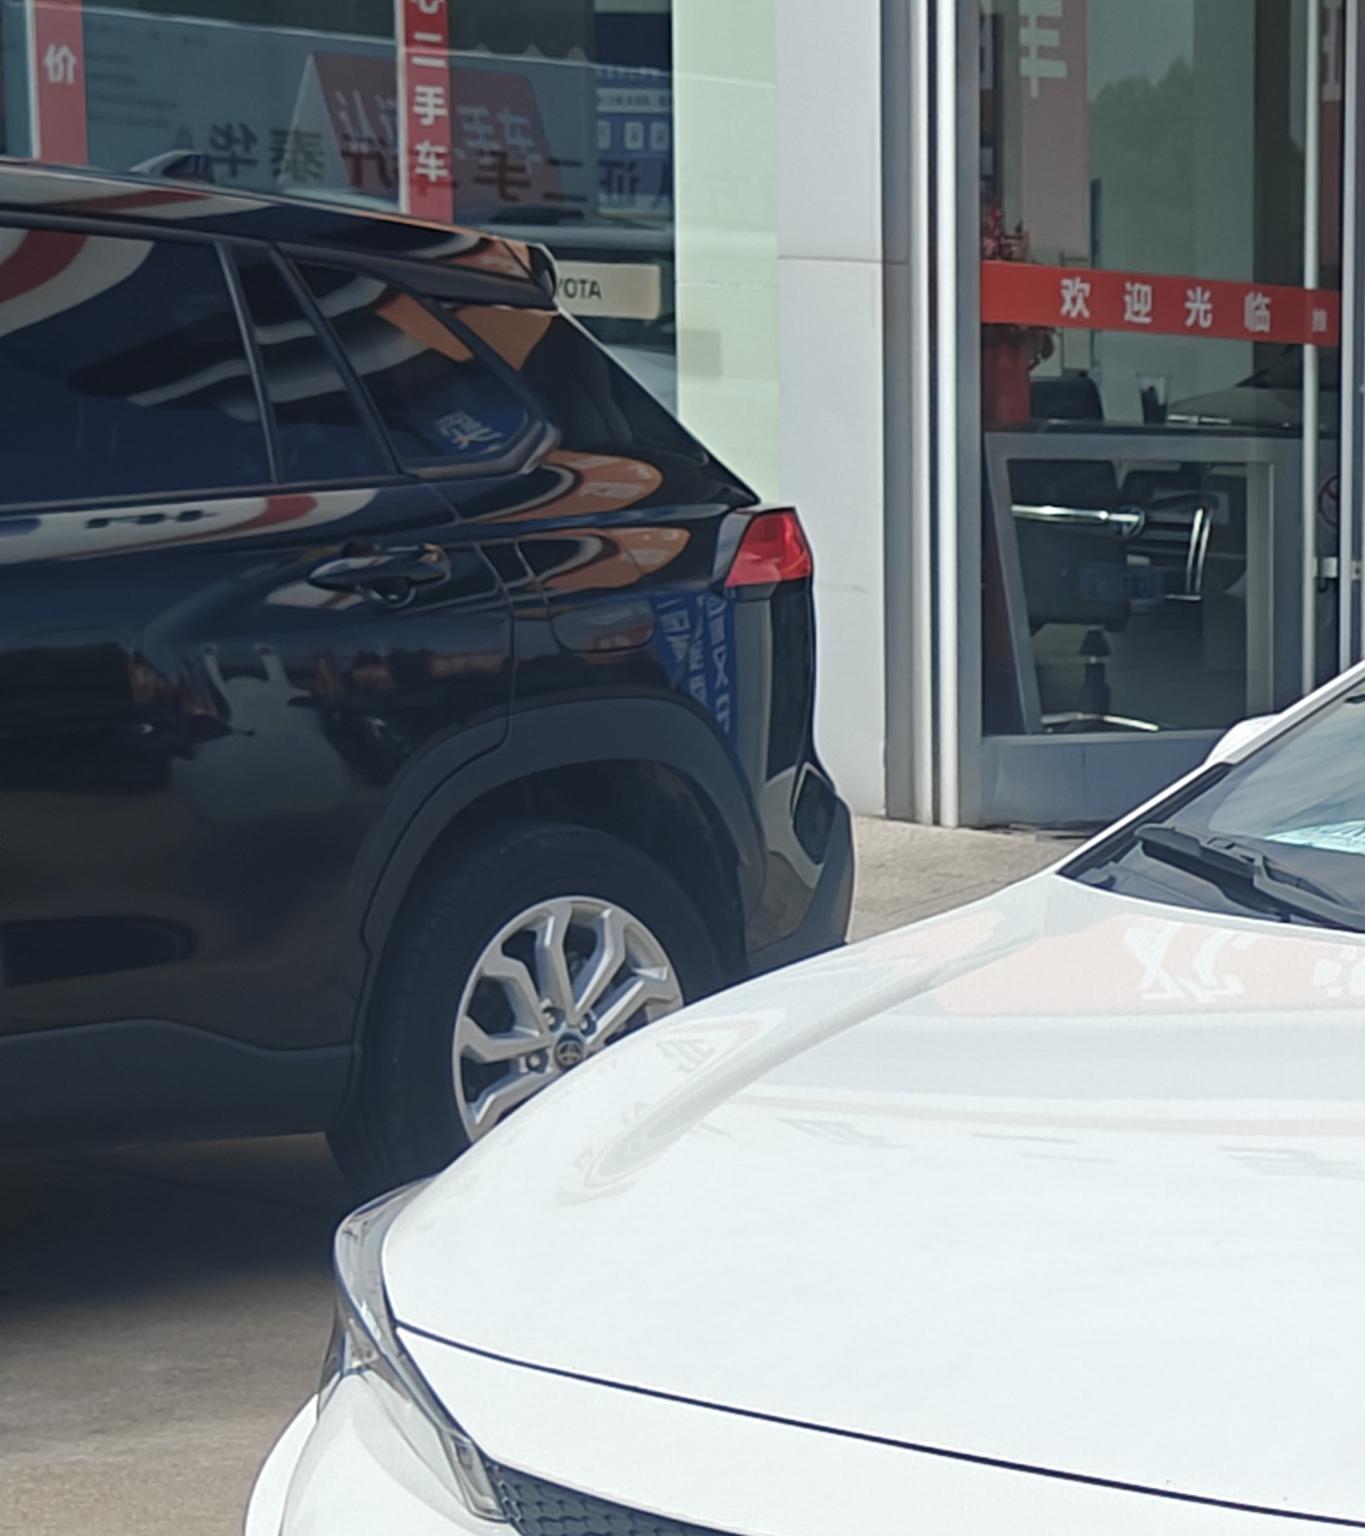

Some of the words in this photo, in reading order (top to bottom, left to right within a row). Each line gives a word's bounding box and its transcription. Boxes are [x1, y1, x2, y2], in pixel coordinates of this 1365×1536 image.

[44, 44, 78, 85] 价
[557, 277, 603, 299] OTA
[1060, 277, 1272, 333] 欢迎光临
